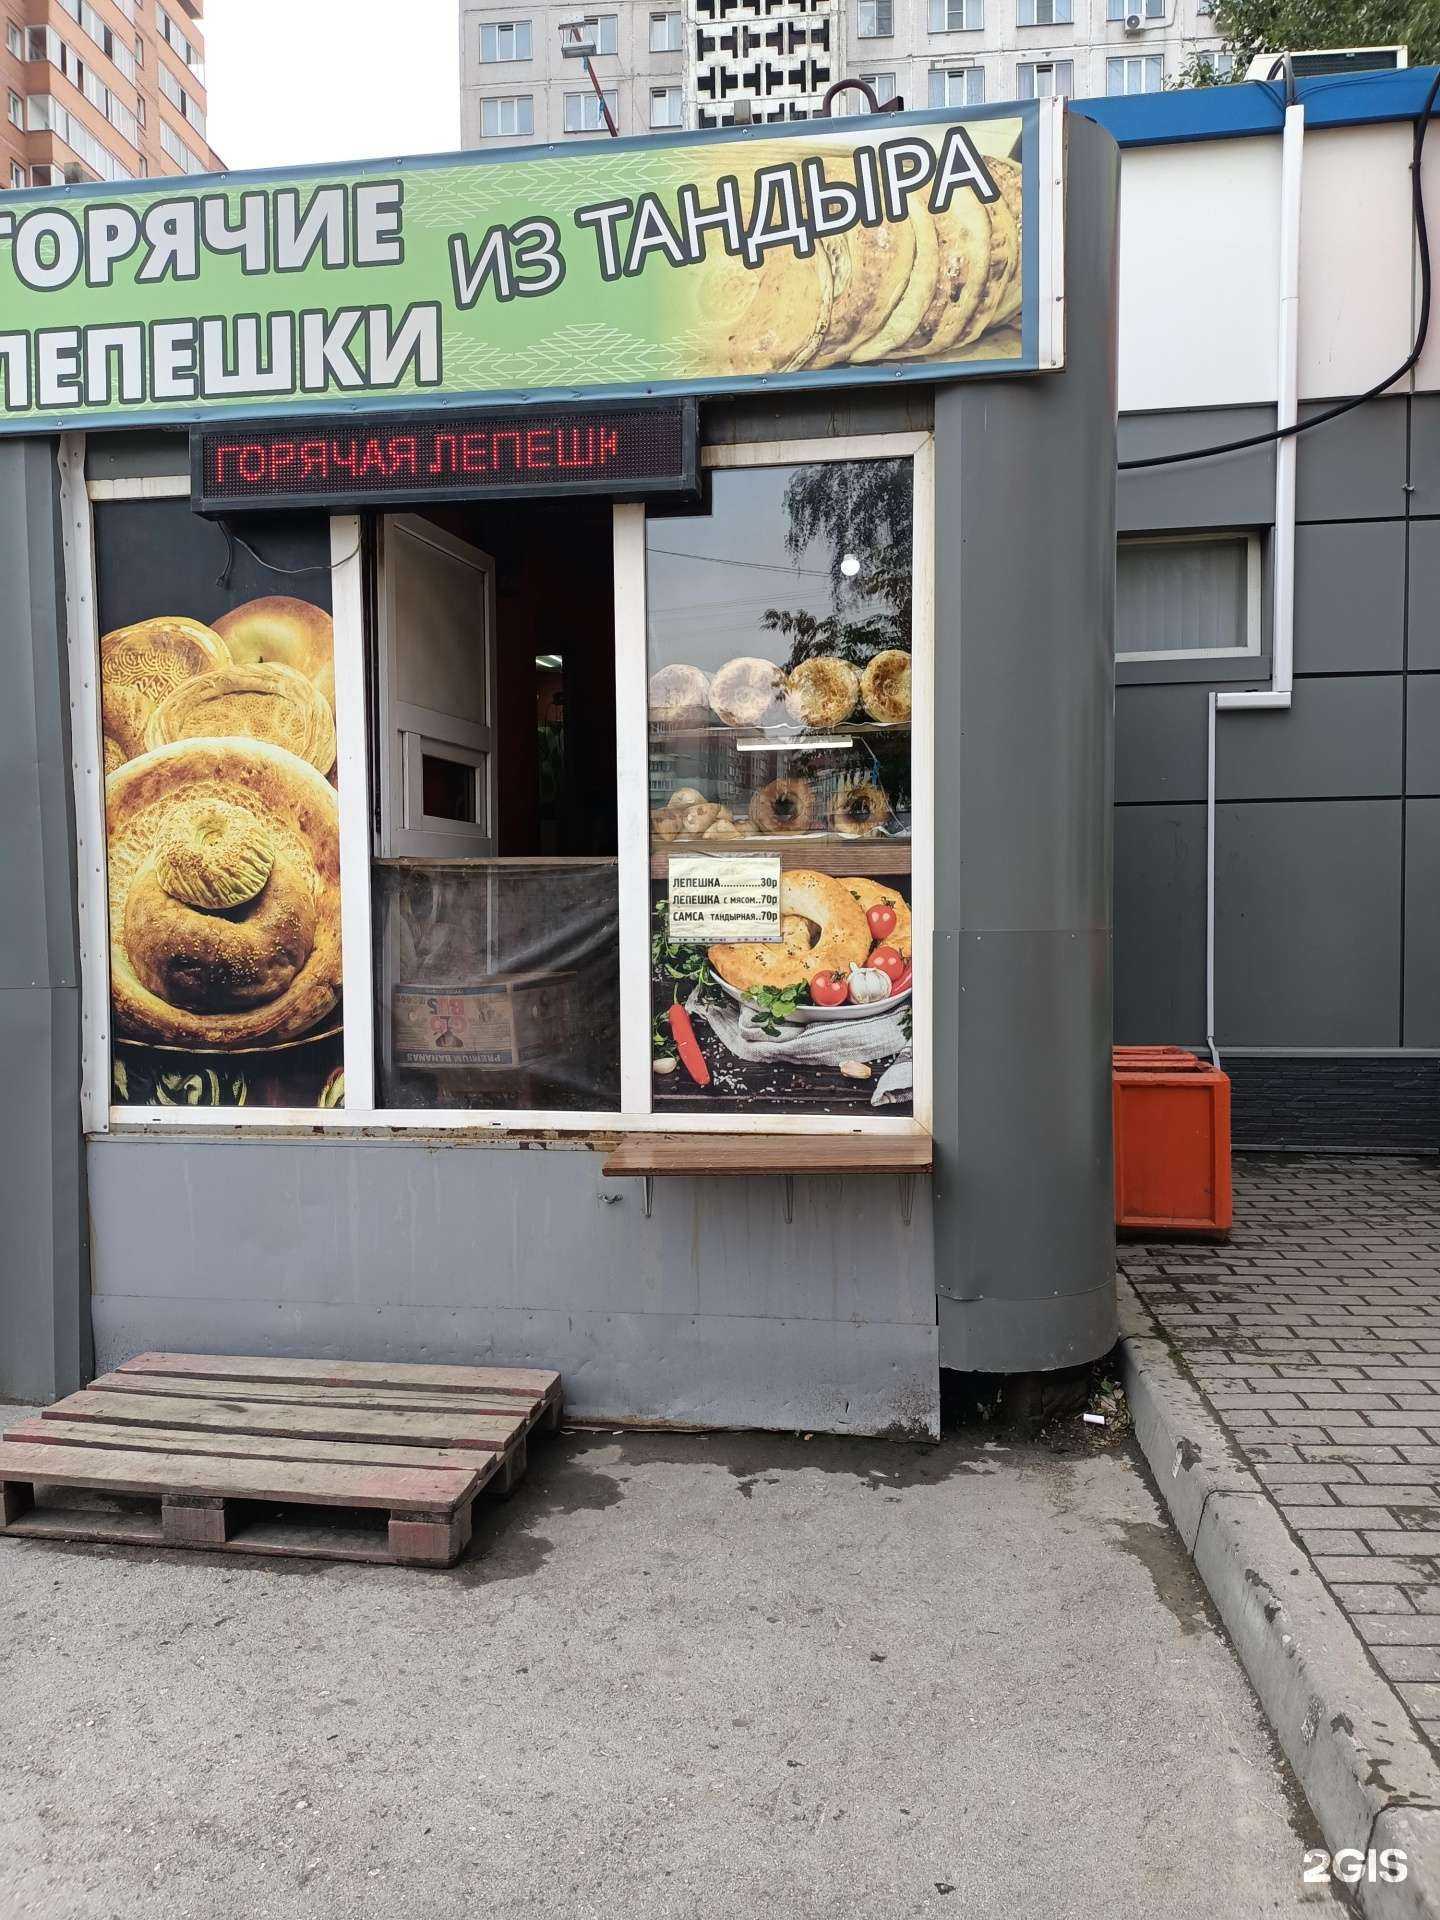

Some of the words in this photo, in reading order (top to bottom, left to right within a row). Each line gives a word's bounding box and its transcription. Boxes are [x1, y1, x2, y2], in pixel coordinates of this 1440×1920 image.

[449, 215, 567, 310] ИЗ
[575, 125, 1001, 282] ТАНДЫРА
[216, 434, 417, 483] ГОРЯЧАЯ
[673, 878, 720, 887] ЛЕПЕШКА
[673, 895, 720, 904] ЛЕПЕШКА
[673, 912, 705, 921] САМСА
